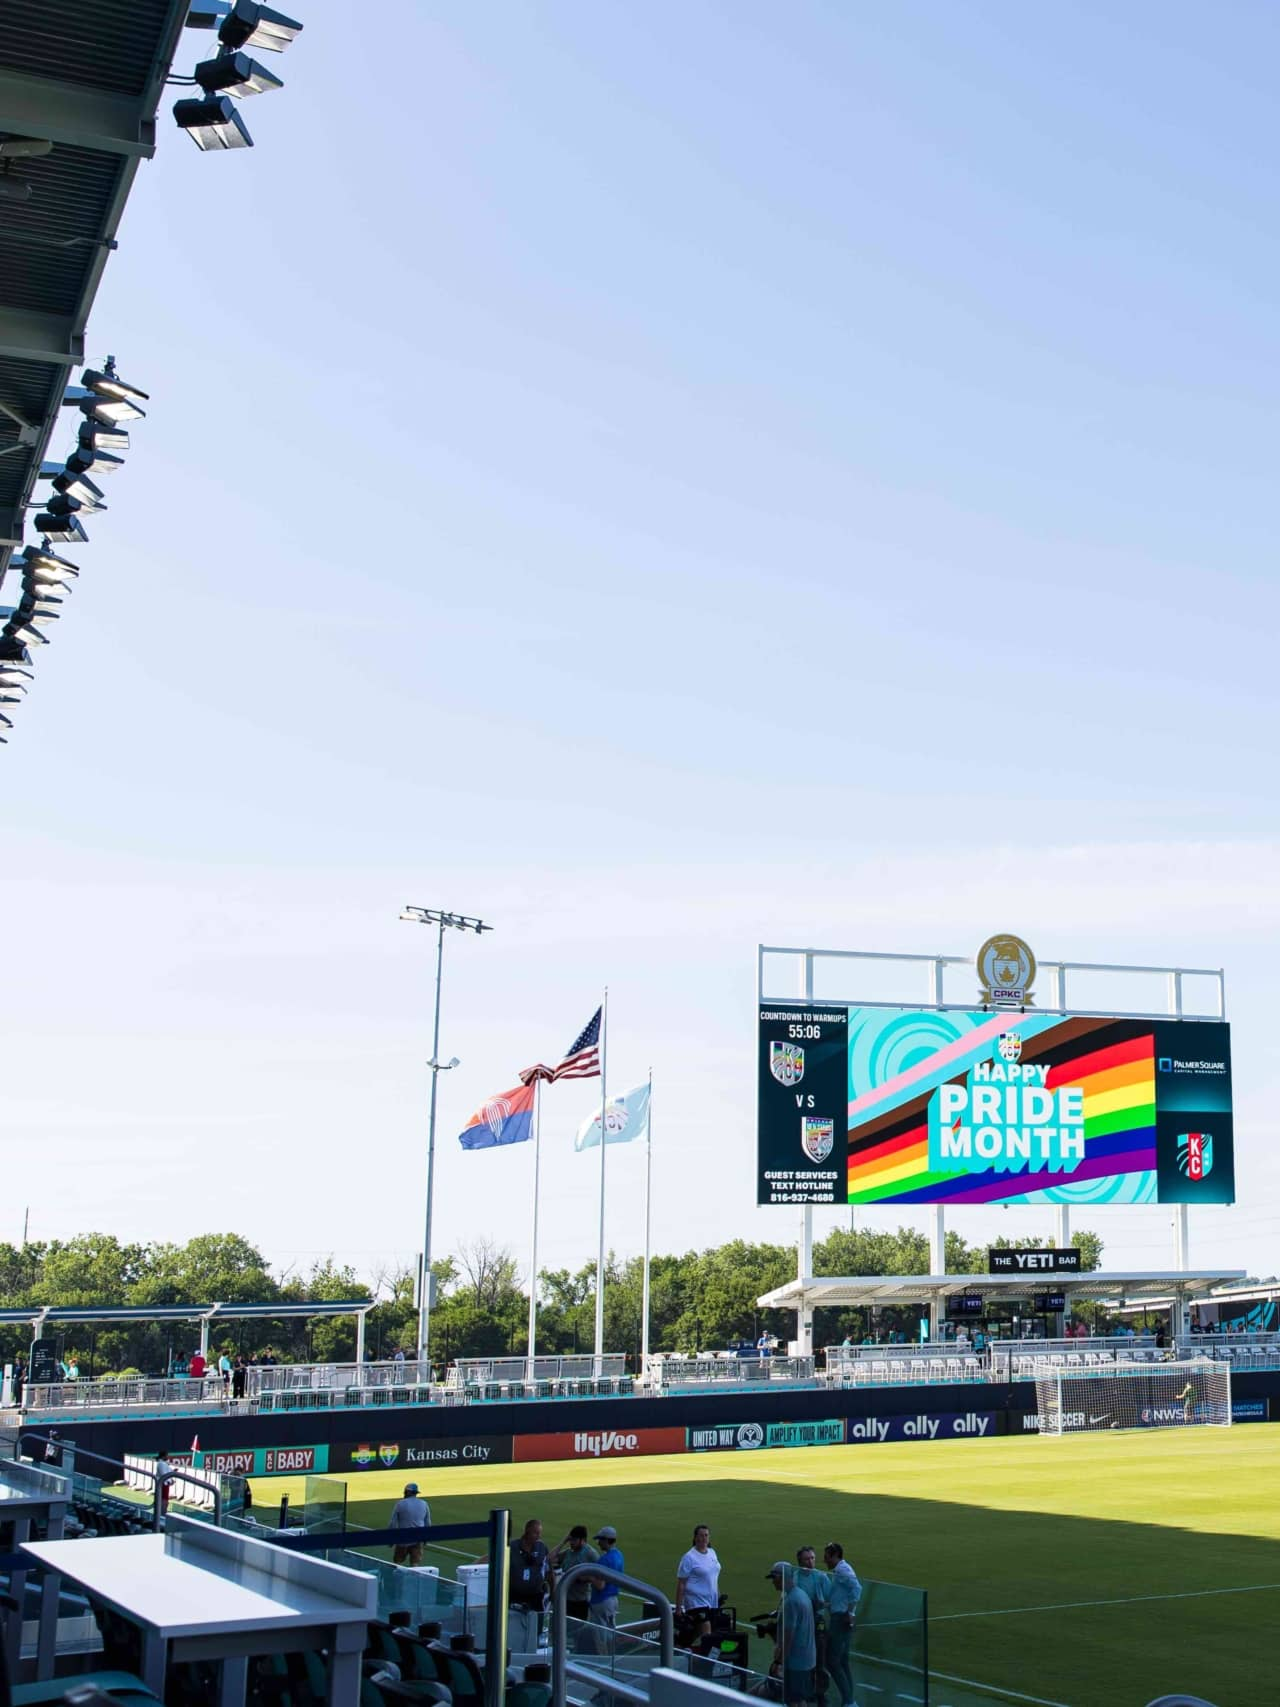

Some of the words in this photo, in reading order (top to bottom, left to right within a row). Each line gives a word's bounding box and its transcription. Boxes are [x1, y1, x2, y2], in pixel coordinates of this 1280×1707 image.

[994, 990, 1020, 998] CPKC
[761, 1011, 802, 1021] COUNTDOWN
[803, 1013, 812, 1022] TO
[813, 1014, 847, 1023] WARMUPS
[788, 1024, 821, 1039] 55:06
[973, 1063, 1051, 1083] HAPPY
[940, 1084, 1084, 1125] PRIDE
[940, 1126, 1086, 1159] MONTH
[765, 1171, 794, 1180] GUEST
[795, 1171, 838, 1180] SERVICES
[771, 1182, 795, 1190] TEXT
[795, 1182, 834, 1190] HOTLINE
[993, 1257, 1011, 1265] THE
[1015, 1253, 1053, 1268] YETI
[1058, 1256, 1077, 1265] BAR
[1023, 1414, 1046, 1429] NIKE
[1153, 1408, 1186, 1420] NWS
[854, 1418, 892, 1441] ally
[903, 1415, 941, 1438] ally
[953, 1412, 990, 1436] ally
[693, 1430, 717, 1447] UNITED
[719, 1429, 734, 1446] WAY
[771, 1426, 797, 1442] AMPLIFY
[799, 1425, 816, 1441] YOUR
[818, 1424, 841, 1441] IMPACT
[277, 1450, 313, 1469] BABY
[406, 1448, 458, 1461] Kansas
[462, 1445, 491, 1460] City
